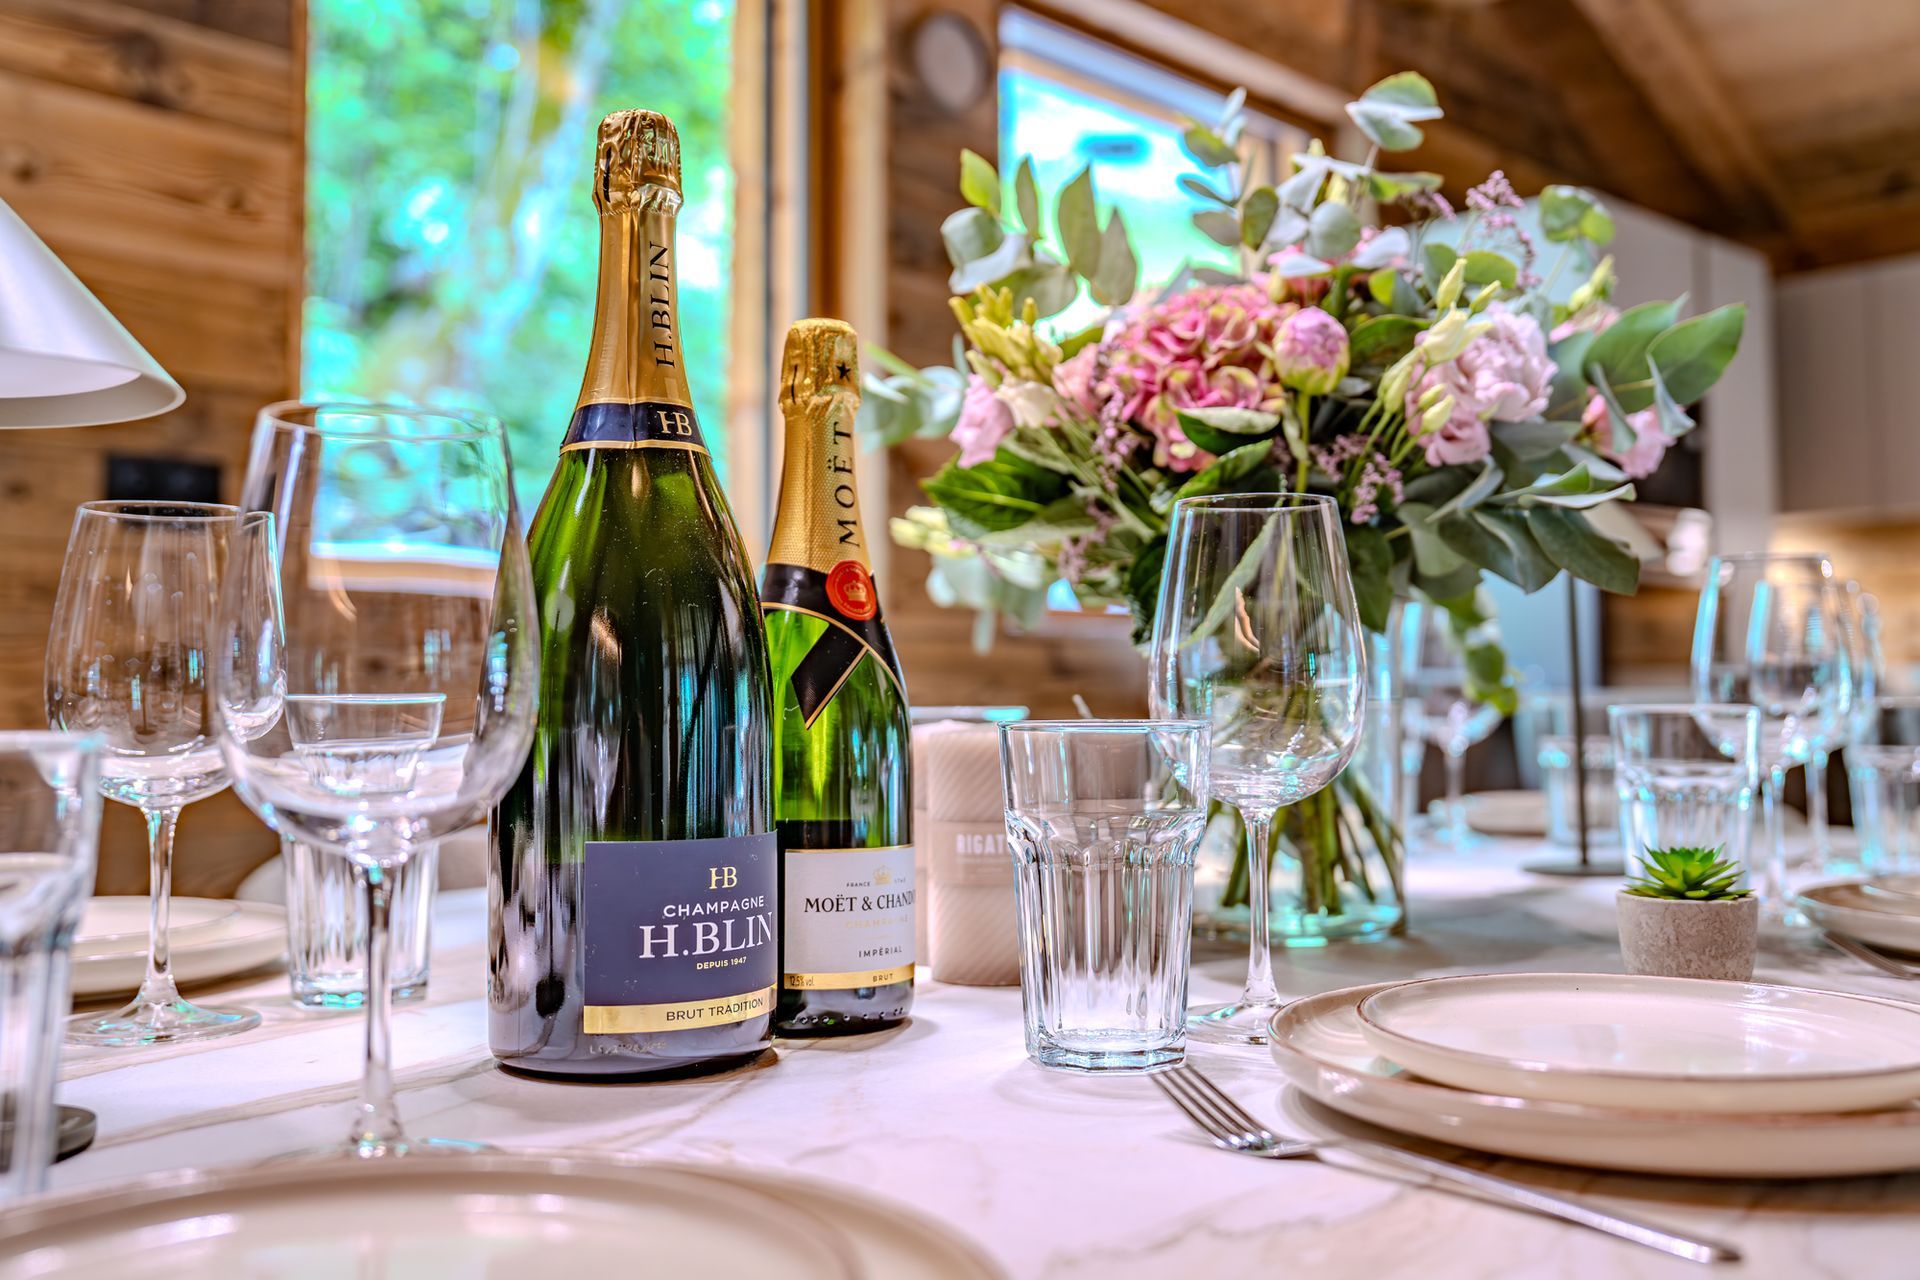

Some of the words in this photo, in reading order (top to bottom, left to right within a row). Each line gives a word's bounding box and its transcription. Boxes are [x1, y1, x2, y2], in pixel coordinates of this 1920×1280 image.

[649, 242, 676, 369] H.BLIN
[827, 421, 860, 549] MOËT
[663, 895, 765, 918] CHAMPAGNE
[804, 894, 857, 912] MOËT
[861, 896, 872, 911] &
[639, 911, 773, 959] H.BLIN
[696, 959, 729, 970] DEPUIS
[730, 956, 747, 966] 1947
[858, 945, 902, 958] IMPÉRIAL
[872, 973, 894, 983] BRUT
[666, 1008, 704, 1022] BRUT
[708, 998, 764, 1017] TRADITION
